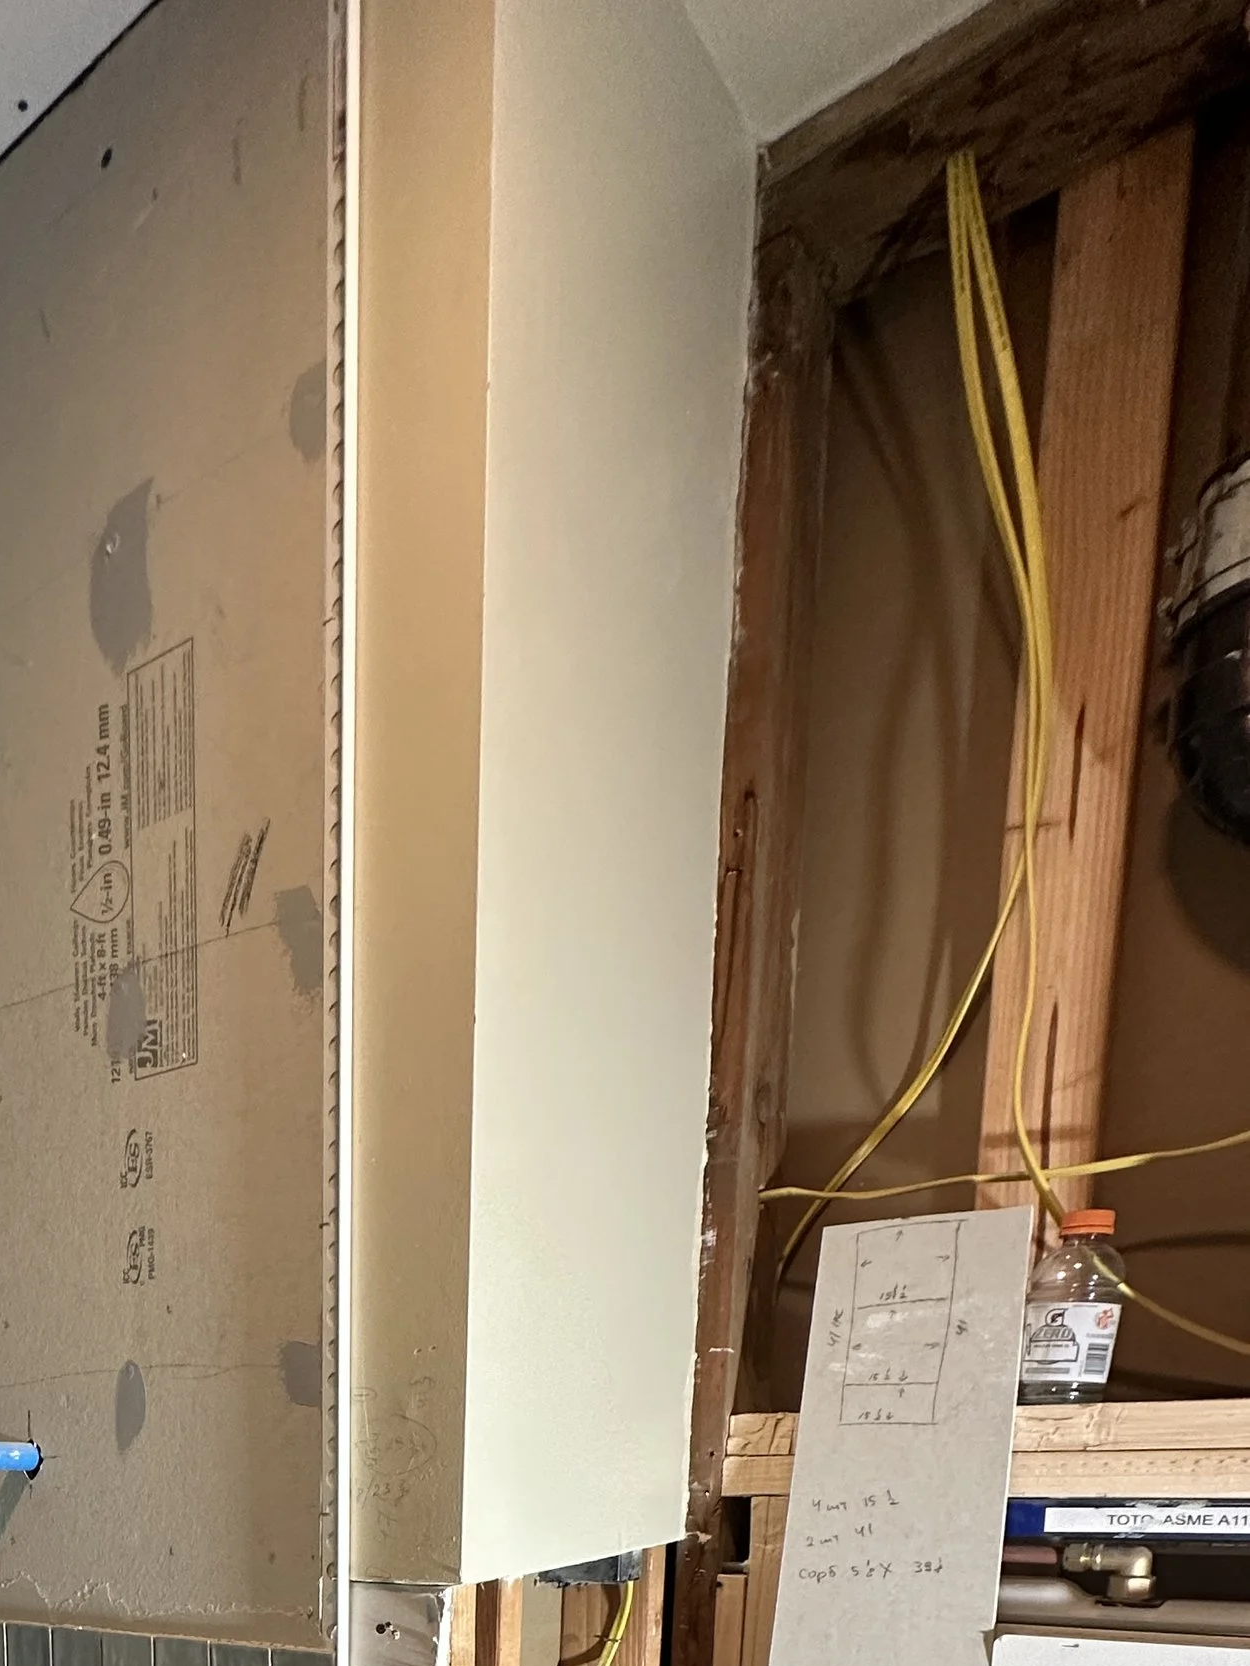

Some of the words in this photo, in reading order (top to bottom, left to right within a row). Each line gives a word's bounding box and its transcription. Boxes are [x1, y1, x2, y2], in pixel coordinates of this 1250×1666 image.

[98, 703, 110, 739] mm
[96, 744, 111, 782] 12.4
[98, 791, 112, 856] 0.49-in
[97, 932, 107, 958] 8-ft
[110, 927, 119, 956] mm
[98, 972, 107, 1001] 4-ft
[128, 1142, 140, 1173] ES
[1163, 1514, 1214, 1527] ASME
